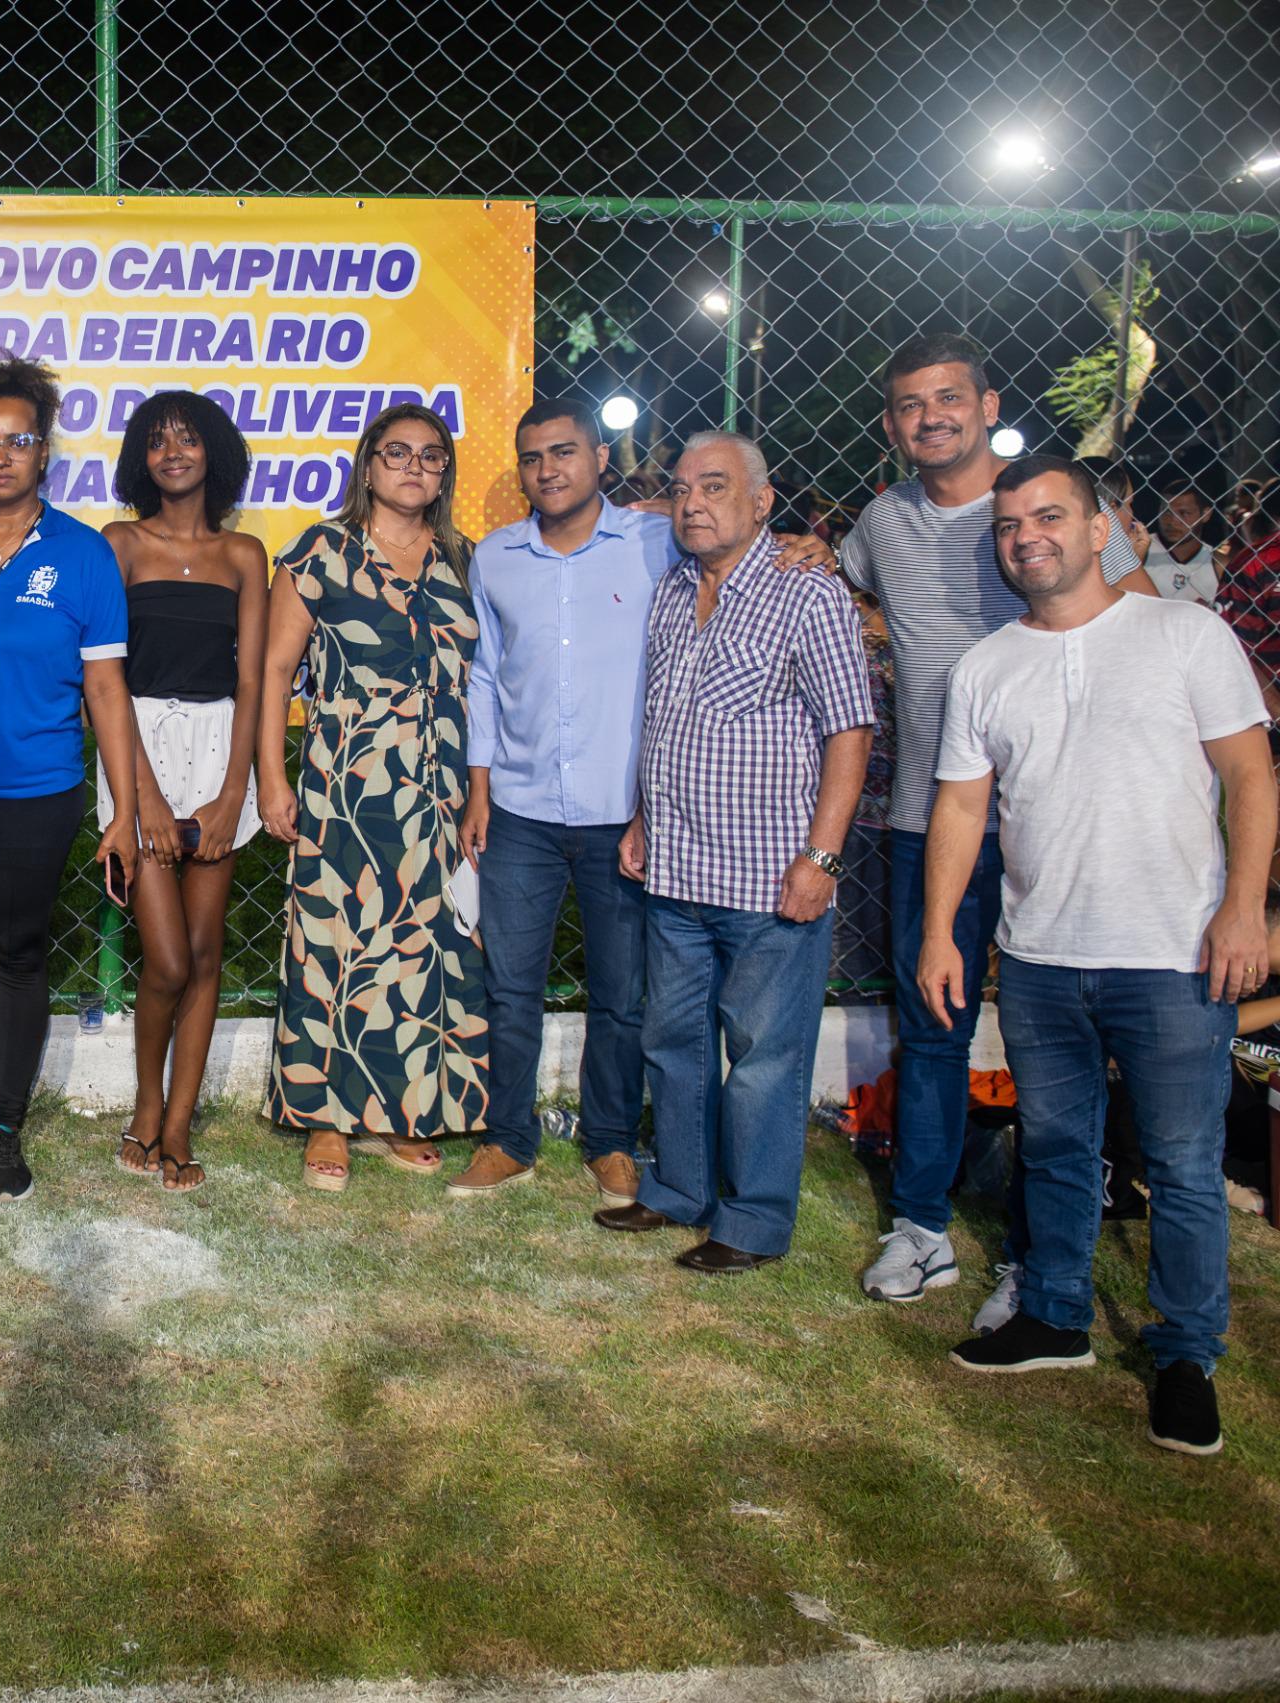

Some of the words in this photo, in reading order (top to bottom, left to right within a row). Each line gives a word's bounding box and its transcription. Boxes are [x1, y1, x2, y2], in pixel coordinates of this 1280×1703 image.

[108, 247, 416, 293] CAMPINHO
[79, 318, 254, 362] BEIRA
[265, 318, 365, 363] RIO
[107, 388, 187, 432] D
[15, 595, 55, 609] SMASDH
